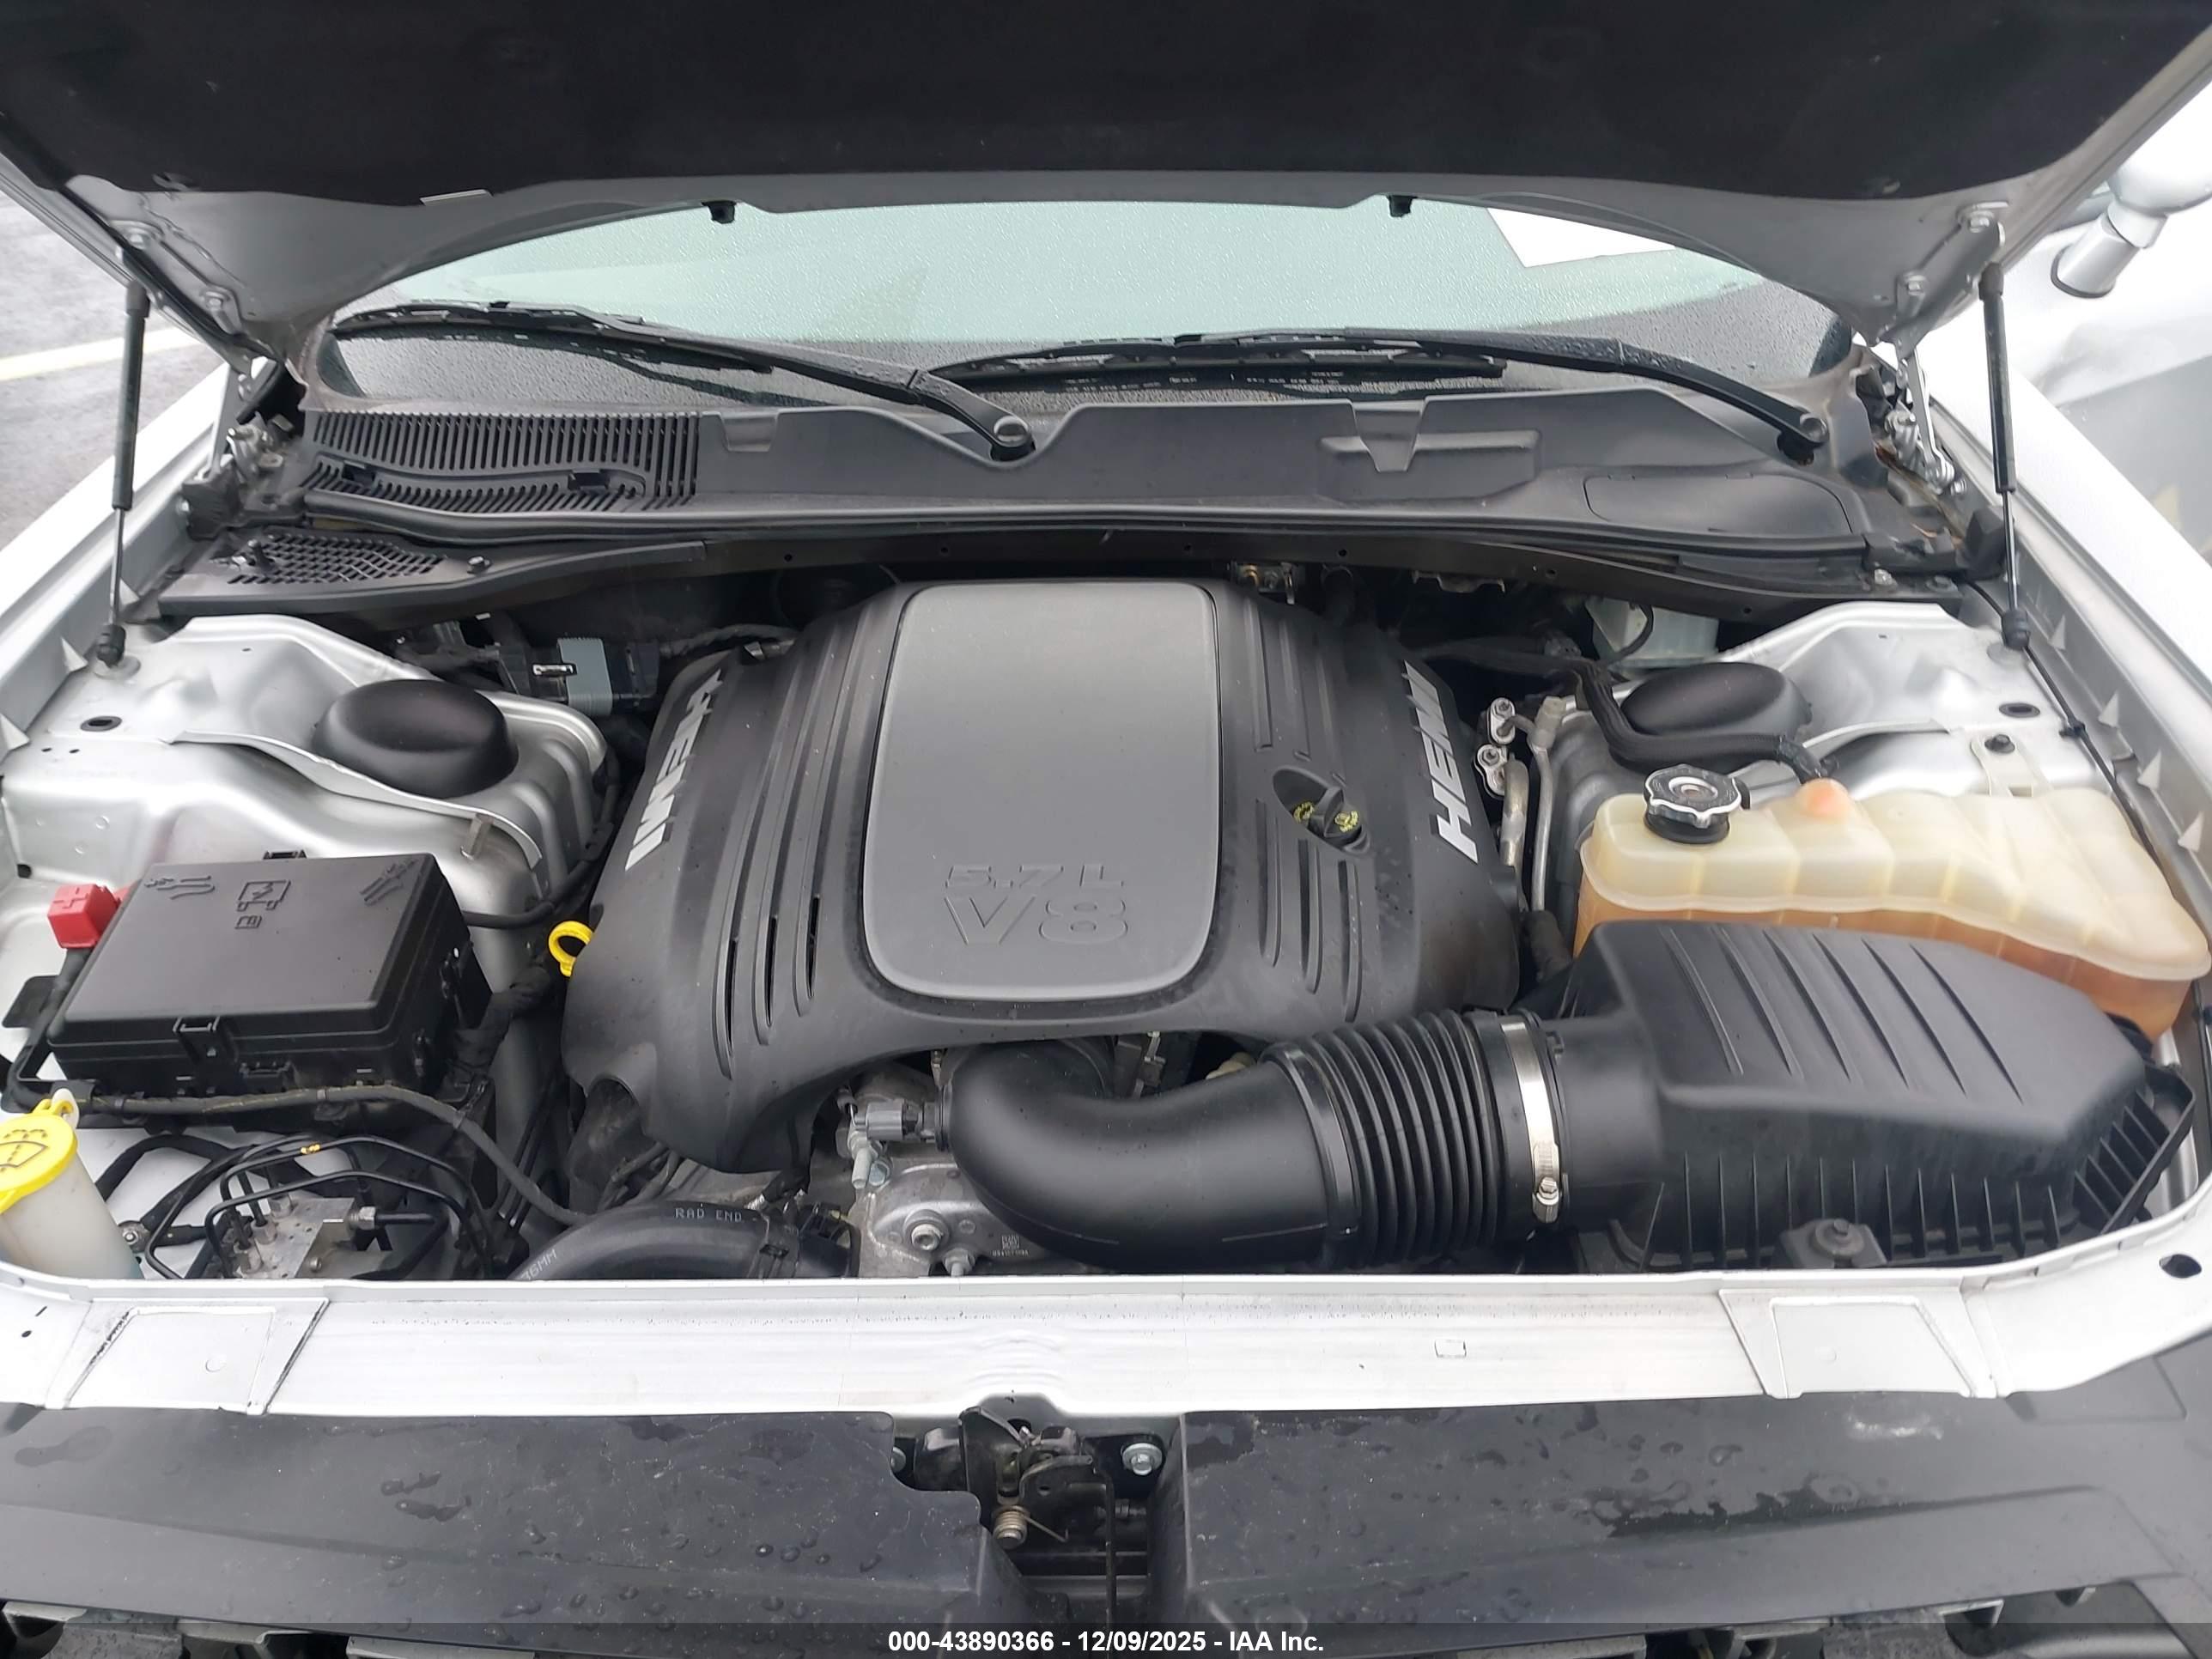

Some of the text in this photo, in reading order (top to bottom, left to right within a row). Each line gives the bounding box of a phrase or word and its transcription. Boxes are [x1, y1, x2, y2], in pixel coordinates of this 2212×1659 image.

[625, 669, 721, 872] HEMI
[1402, 659, 1479, 864] HEMI
[944, 896, 1128, 945] V8
[675, 1207, 742, 1223] RAD END
